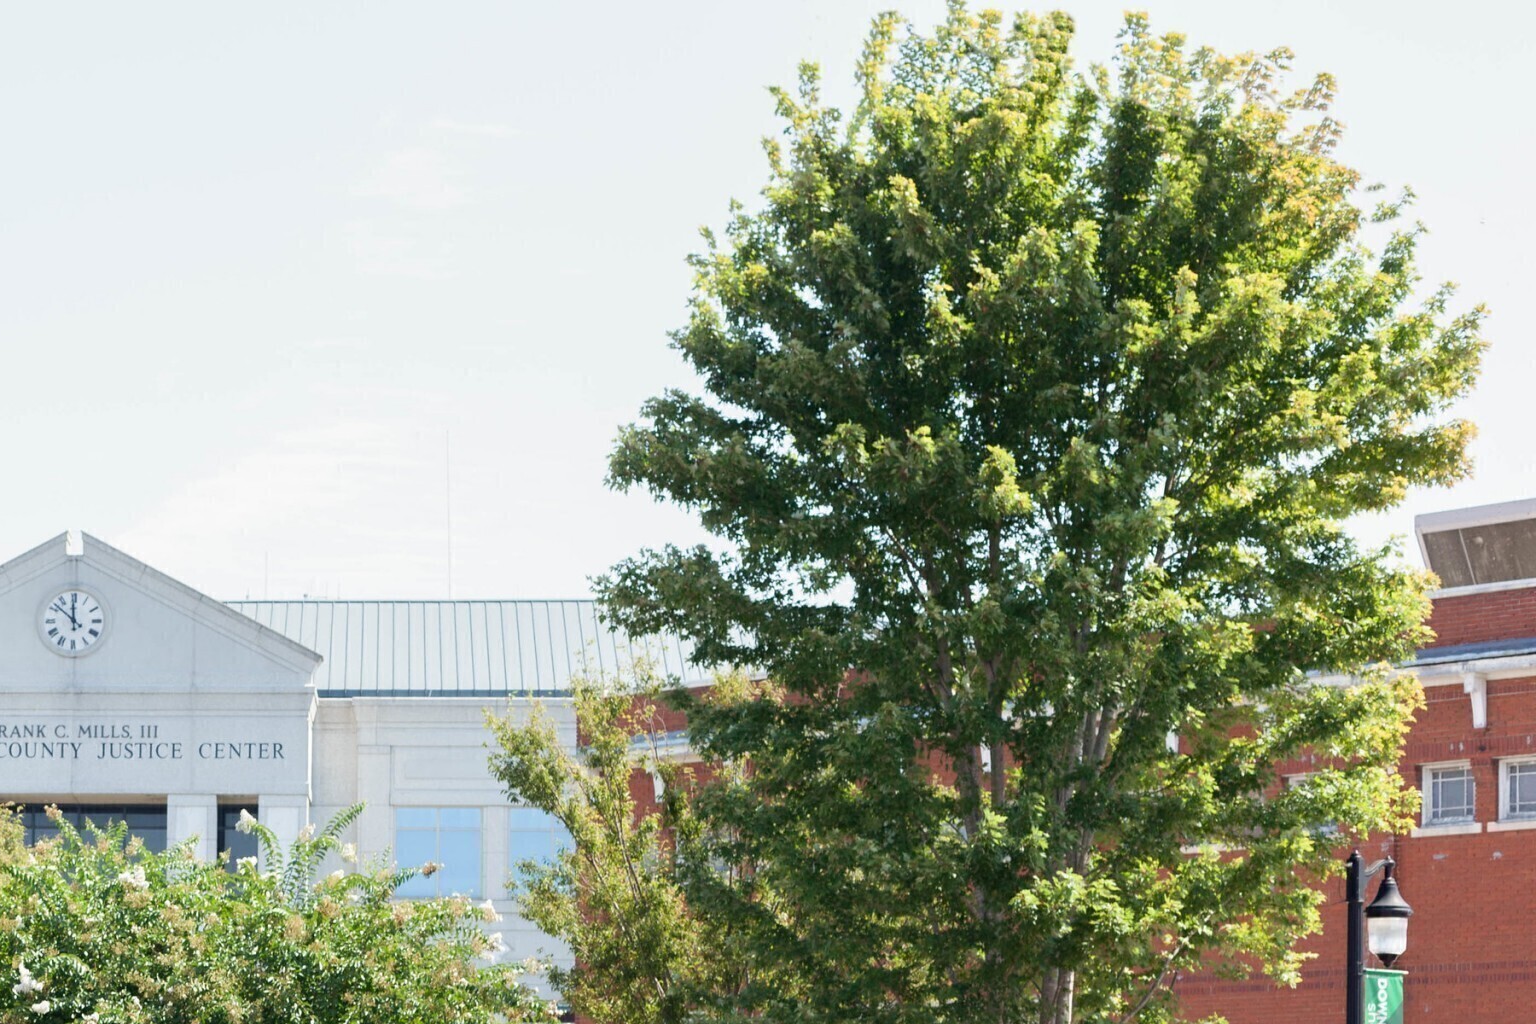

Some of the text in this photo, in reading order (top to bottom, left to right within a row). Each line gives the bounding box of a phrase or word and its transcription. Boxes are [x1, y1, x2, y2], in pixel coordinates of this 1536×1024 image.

[53, 724, 70, 739] C.
[139, 725, 159, 739] III
[97, 741, 184, 759] JUSTICE
[198, 741, 286, 759] CENTER
